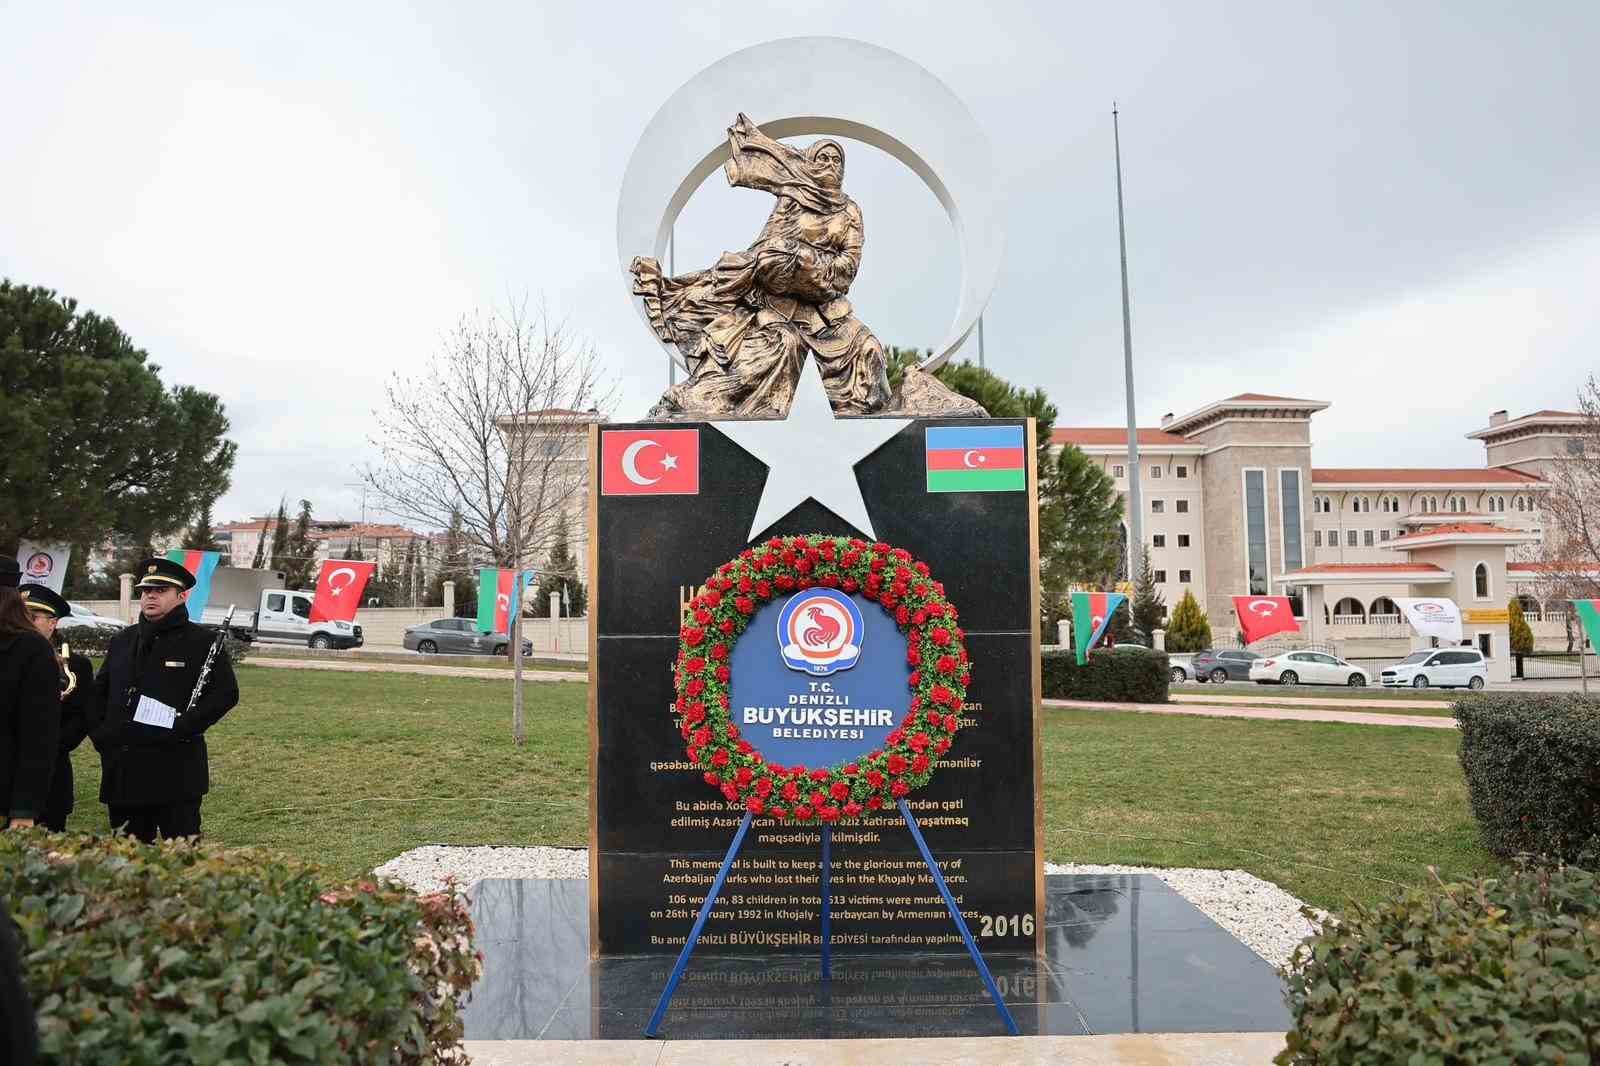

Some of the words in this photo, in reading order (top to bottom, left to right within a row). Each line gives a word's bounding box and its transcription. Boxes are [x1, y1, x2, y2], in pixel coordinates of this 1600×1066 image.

[808, 682, 834, 693] T.C.
[935, 757, 982, 768] rmənilər
[676, 801, 689, 811] Bu
[693, 800, 723, 811] abidə
[941, 799, 963, 811] qətl
[671, 816, 710, 828] edilmiş
[713, 816, 775, 828] Azərbycan
[916, 816, 968, 828] yaşatmaq
[831, 832, 881, 844] kilmişdir.
[669, 859, 690, 869] This
[692, 859, 740, 869] memoal
[743, 859, 751, 869] is
[753, 859, 777, 869] built
[779, 860, 789, 869] to
[792, 859, 816, 871] keep
[843, 859, 861, 869] the
[863, 859, 904, 871] glorious
[906, 861, 949, 871] memry
[951, 858, 962, 869] of
[724, 874, 748, 883] urks
[750, 874, 772, 883] who
[774, 873, 793, 883] lost
[795, 873, 820, 883] their
[847, 874, 856, 883] in
[859, 873, 876, 883] the
[878, 873, 915, 886] Khojaly
[918, 874, 968, 884] Maacre.
[668, 895, 686, 904] 106
[689, 896, 729, 906] woan,
[731, 895, 744, 904] 83
[746, 894, 787, 904] children
[789, 895, 799, 904] in
[801, 895, 822, 904] tota
[848, 895, 887, 904] victims
[888, 896, 911, 904] were
[650, 911, 663, 919] on
[666, 908, 688, 919] 26th
[737, 909, 761, 919] 1992
[764, 909, 774, 919] in
[776, 909, 814, 921] Khojaly
[829, 910, 880, 921] zerbaycan
[882, 909, 894, 921] by
[897, 909, 945, 919] Armenian
[979, 913, 1034, 937] 2016
[651, 936, 664, 945] Bu
[729, 931, 811, 947] BÜYÜKŞEHİR
